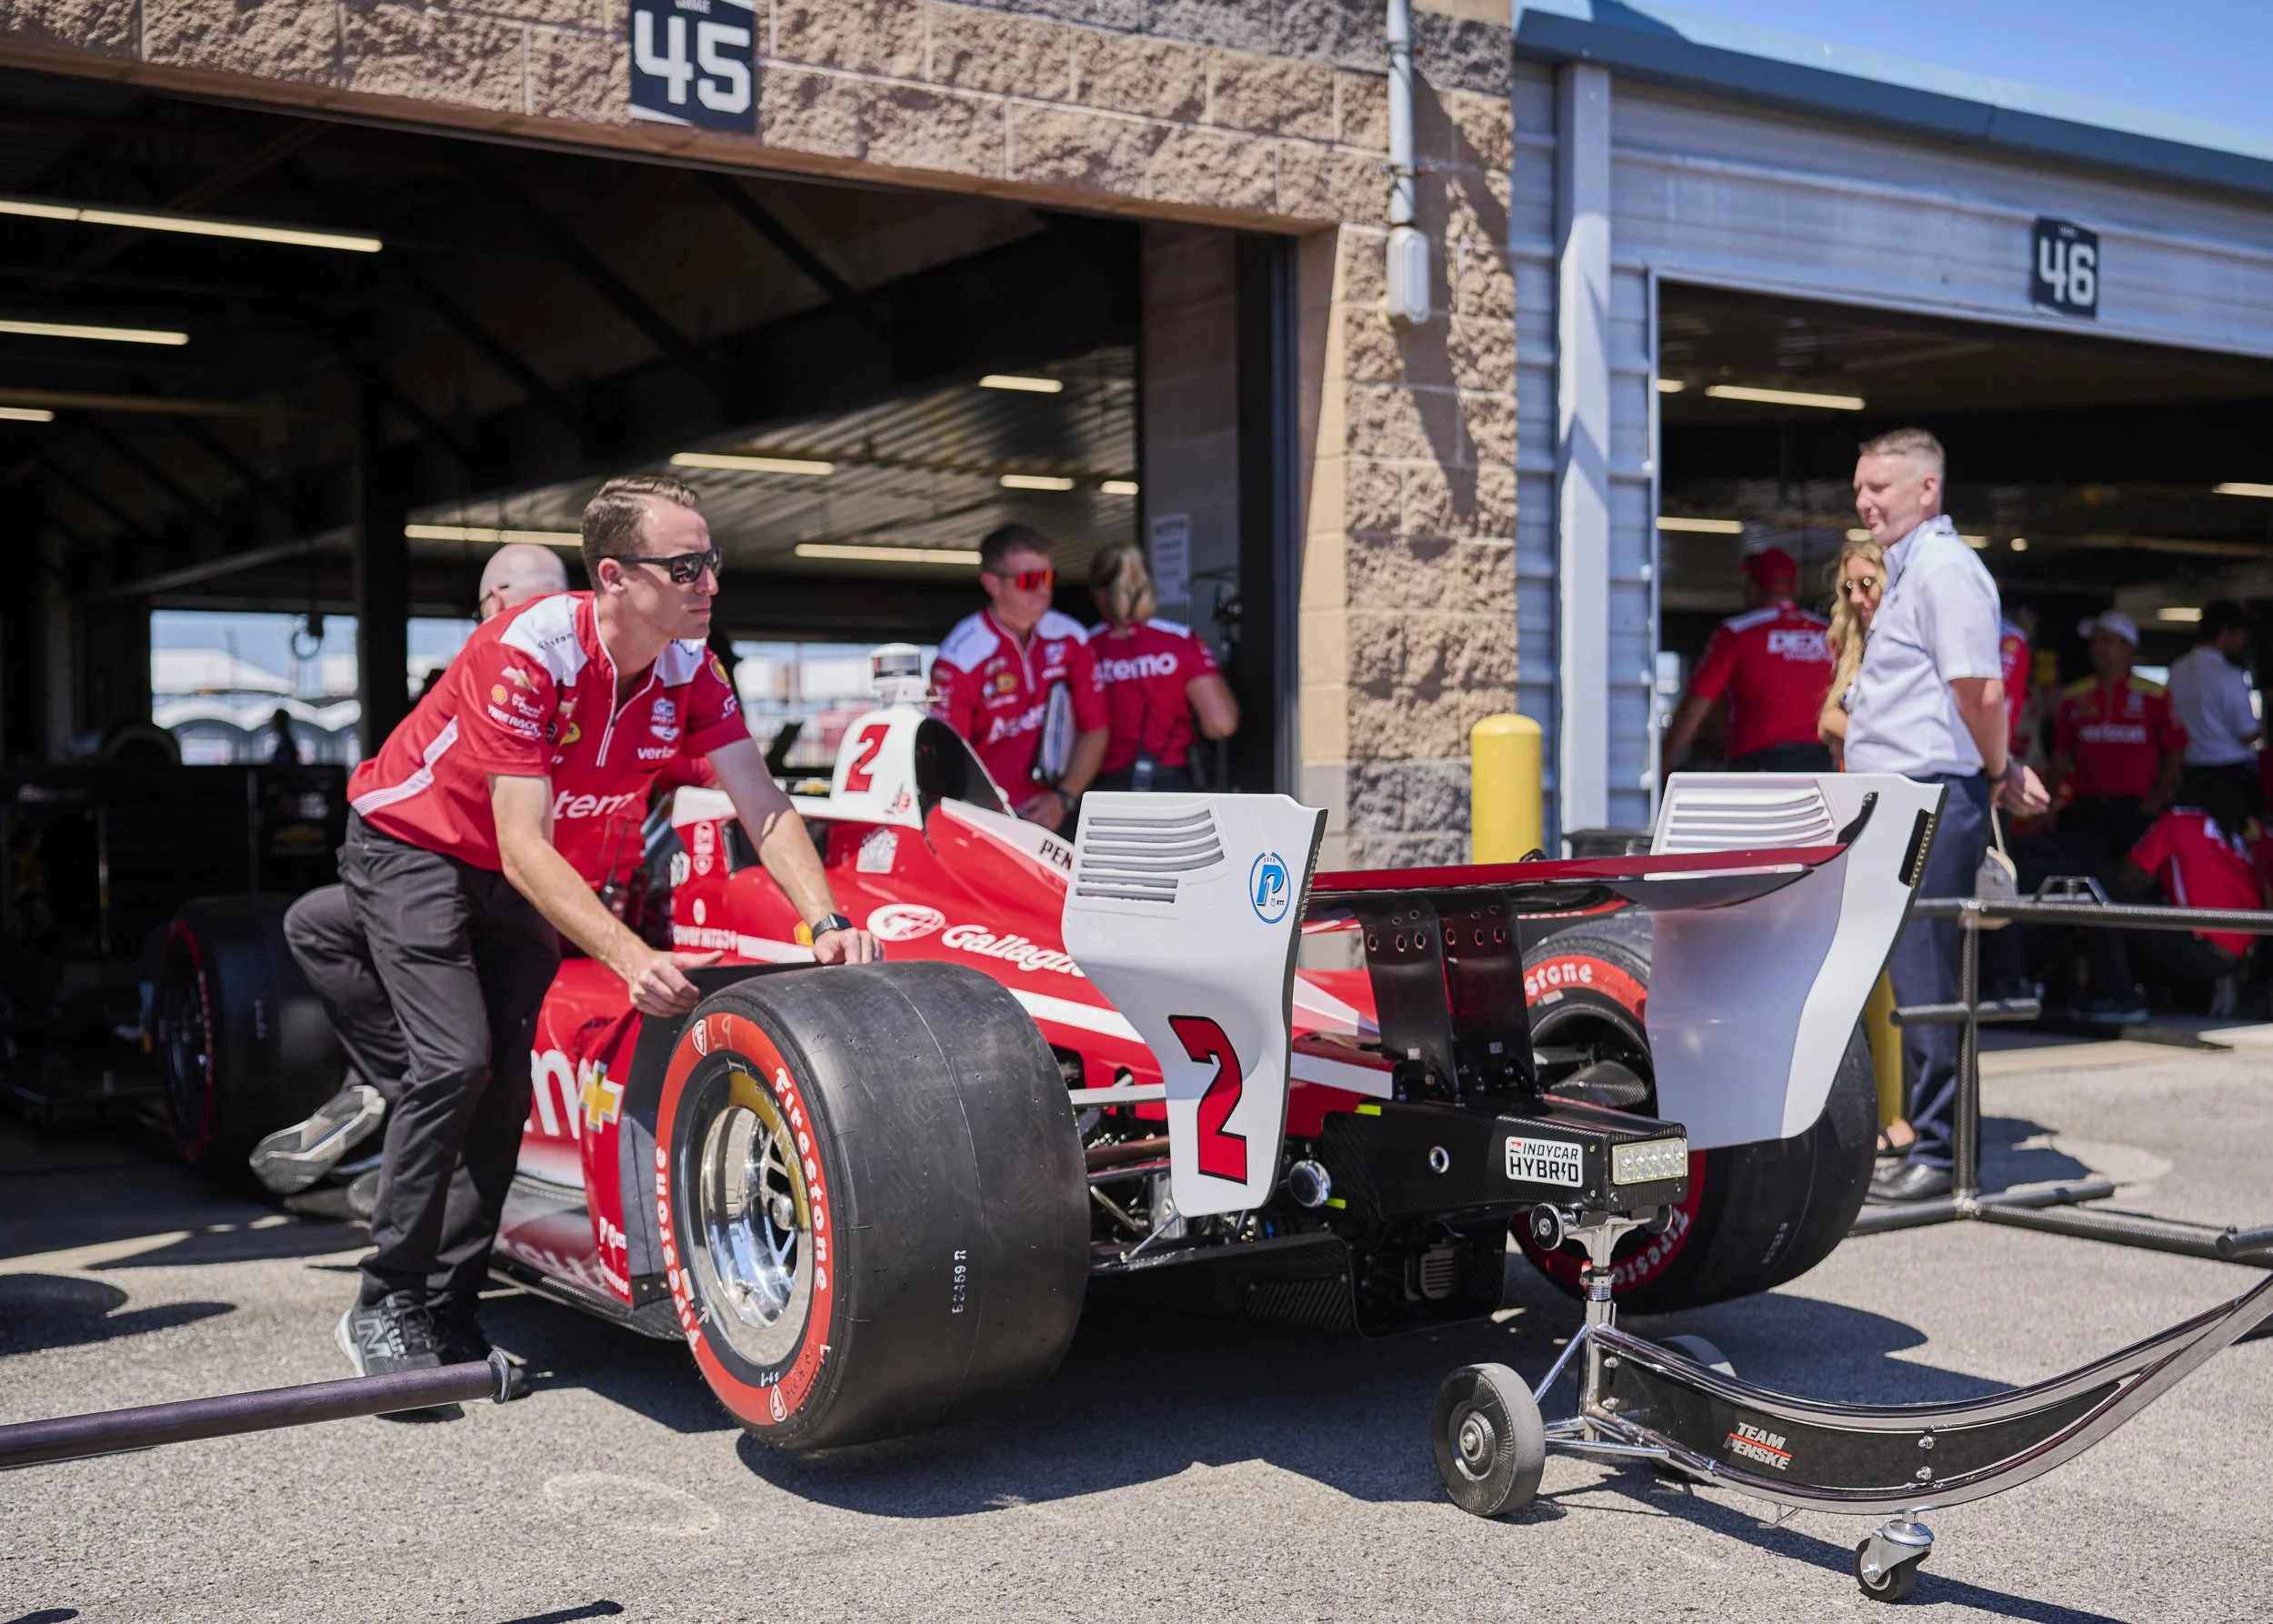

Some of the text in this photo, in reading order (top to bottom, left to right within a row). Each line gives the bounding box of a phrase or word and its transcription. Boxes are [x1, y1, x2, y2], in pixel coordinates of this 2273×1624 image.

[635, 10, 751, 114] 45
[2039, 236, 2095, 306] 46
[845, 724, 890, 792] 2
[1167, 1014, 1247, 1186] 2
[775, 1067, 827, 1291] Firestone
[1523, 1142, 1578, 1160] INDYCAR
[656, 1146, 701, 1353] Firestone
[1737, 1421, 1787, 1450] TEAM
